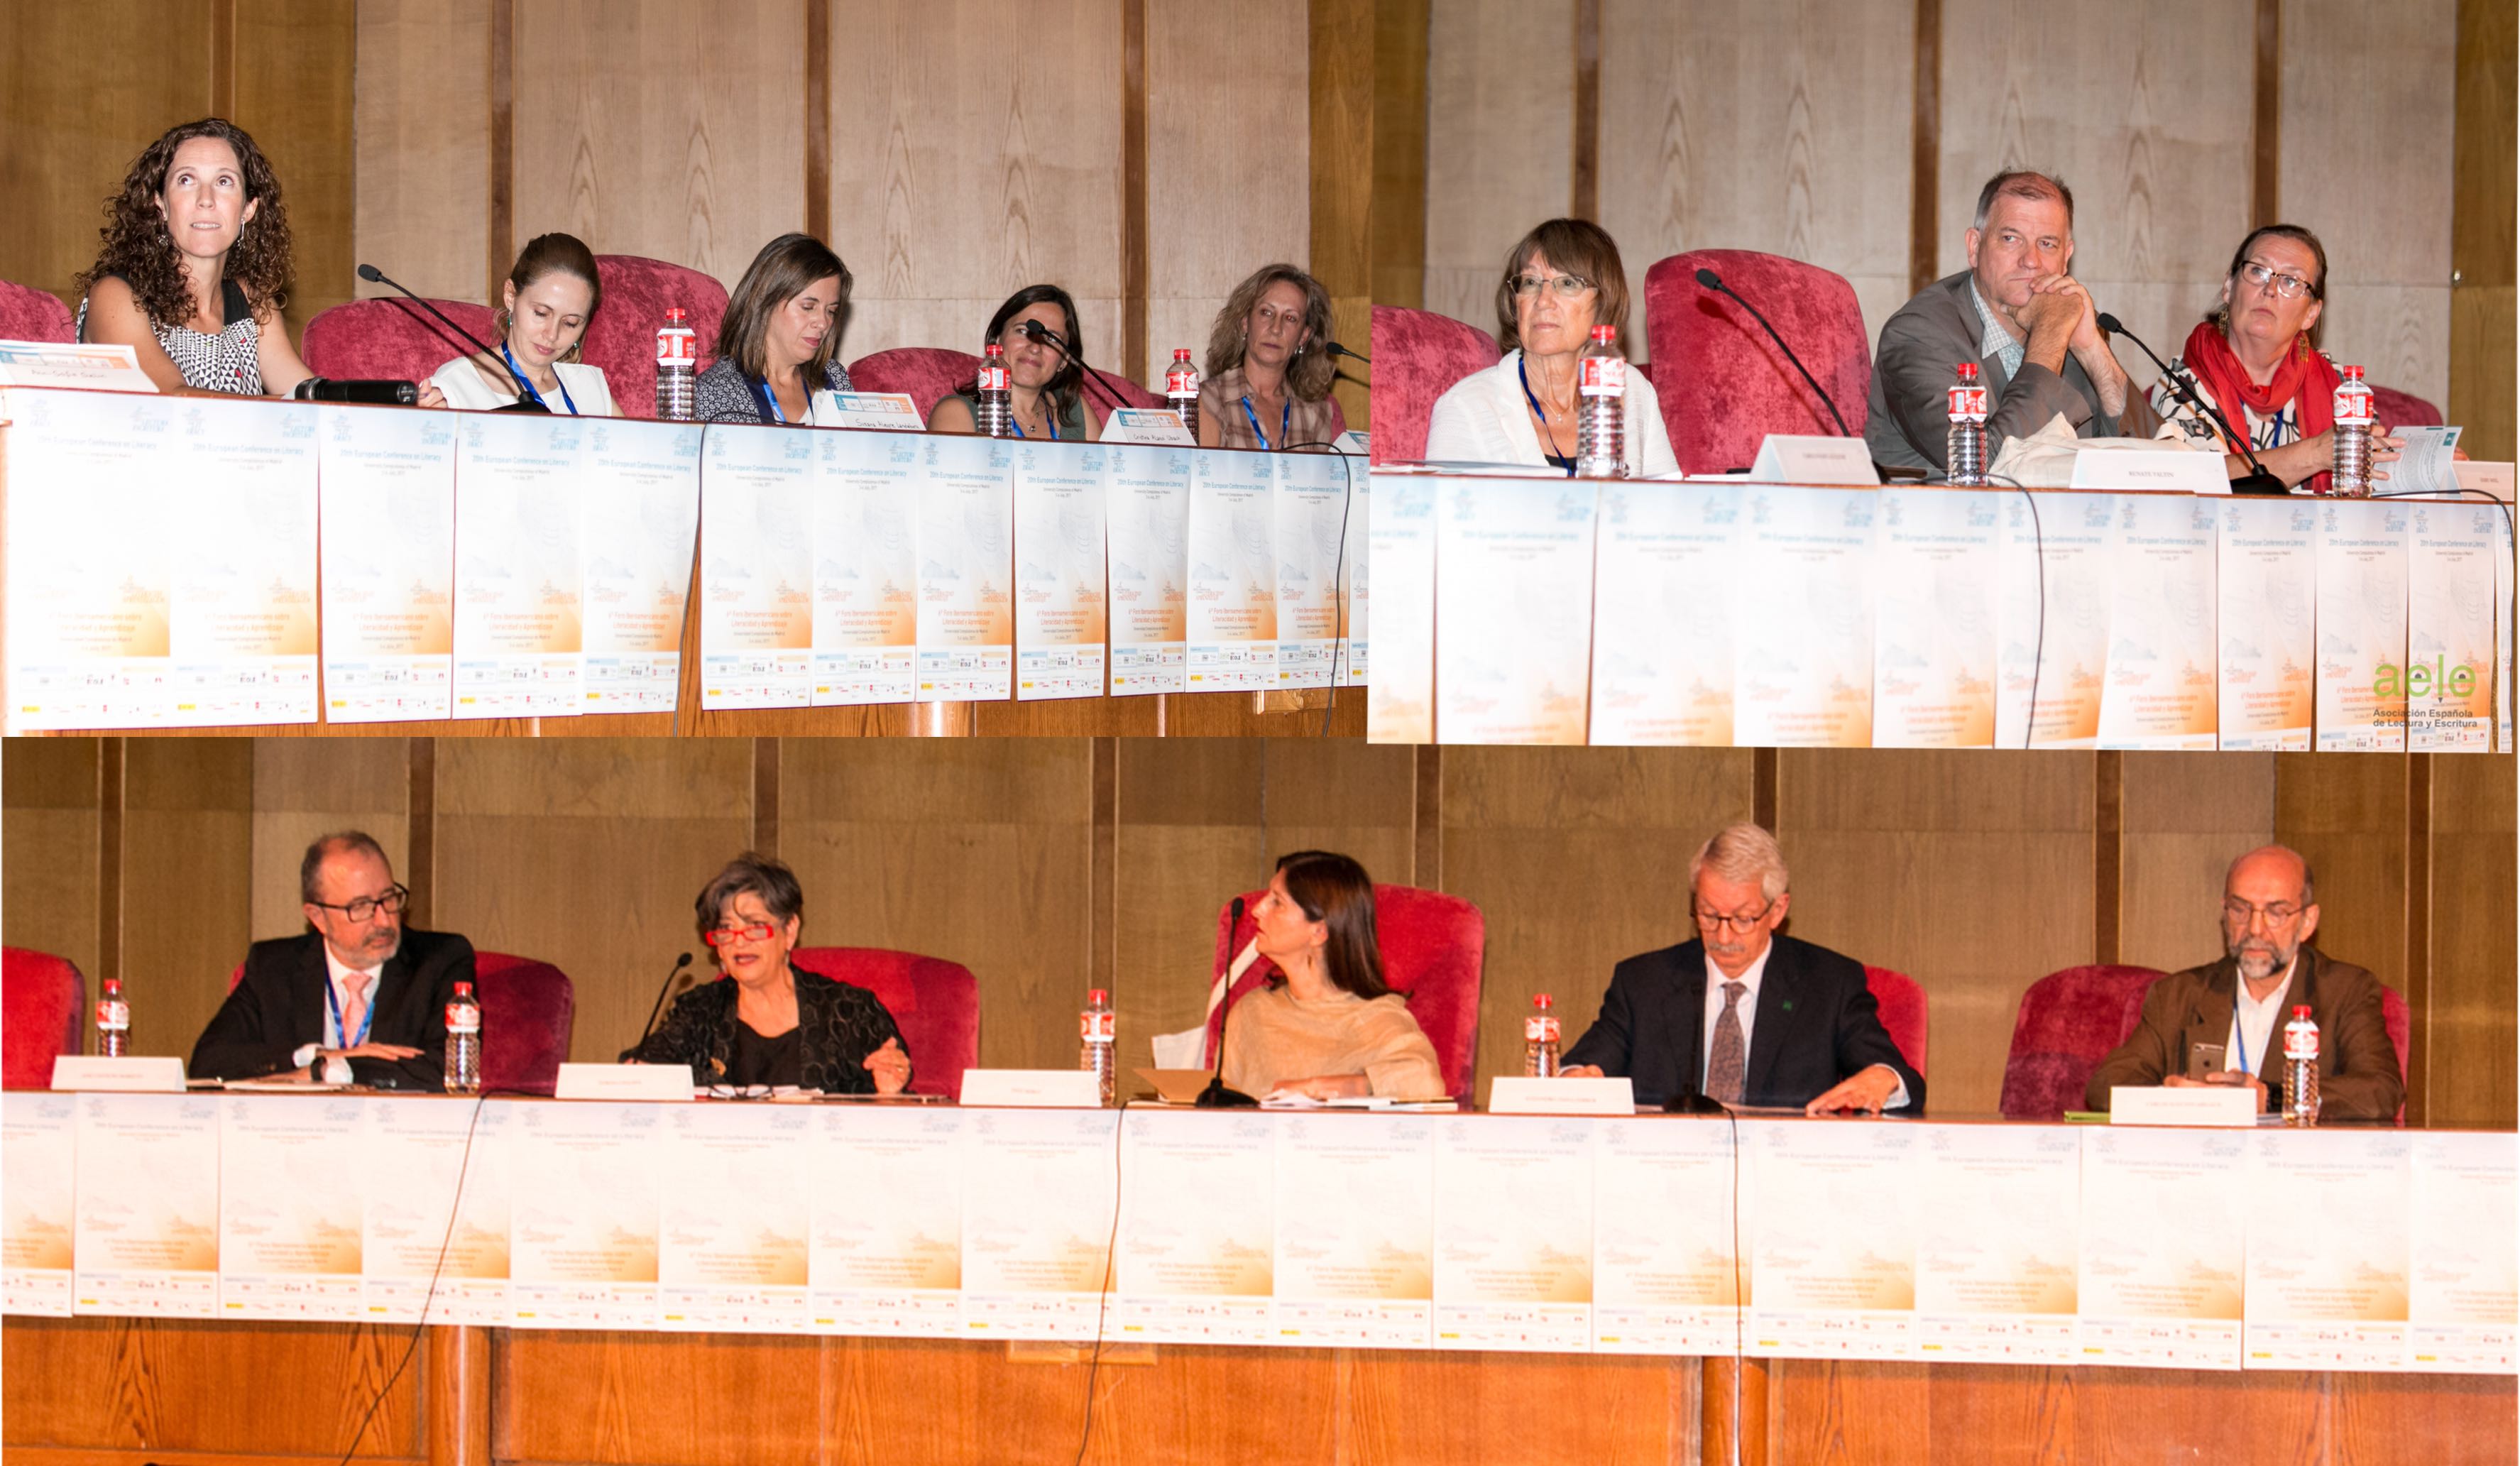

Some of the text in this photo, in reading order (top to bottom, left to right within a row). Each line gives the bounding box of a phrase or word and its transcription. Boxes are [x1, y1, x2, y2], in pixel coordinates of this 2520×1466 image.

[1036, 477, 1056, 486] European
[1082, 478, 1096, 487] Literacy
[1126, 478, 1145, 488] European
[1170, 480, 1184, 489] Literacy
[1211, 482, 1229, 491] European
[1253, 483, 1266, 491] Literacy
[1292, 485, 1308, 494] European
[1330, 486, 1342, 495] Literacy
